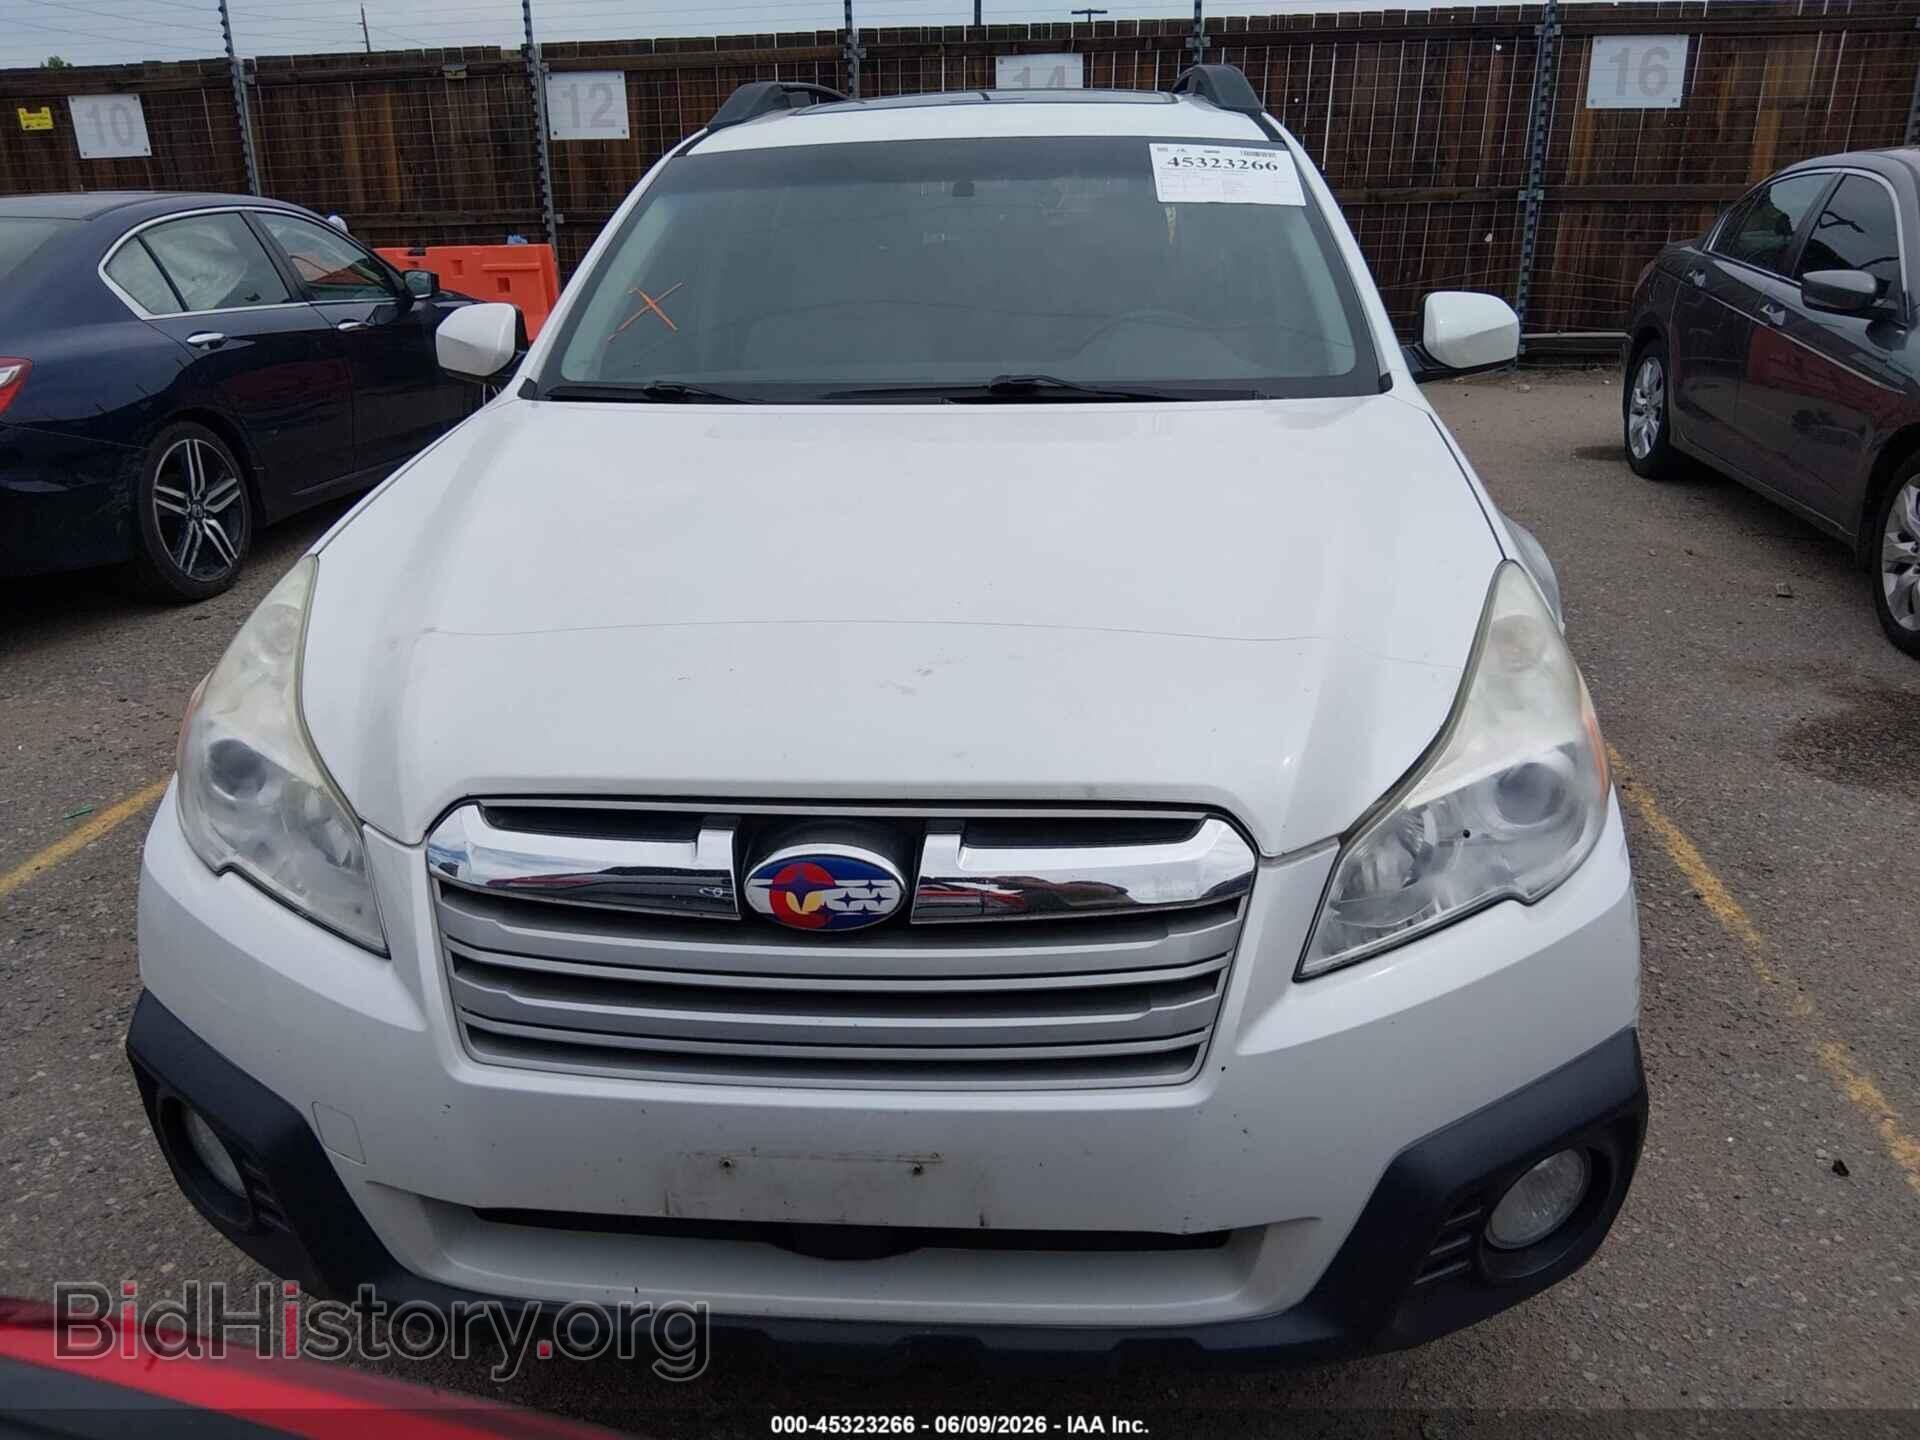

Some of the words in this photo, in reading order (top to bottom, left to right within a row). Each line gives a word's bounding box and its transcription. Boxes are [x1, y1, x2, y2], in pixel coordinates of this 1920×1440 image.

[1609, 46, 1671, 97] 16
[86, 103, 134, 147] 10
[561, 83, 616, 128] 12
[1167, 156, 1279, 172] 45323266
